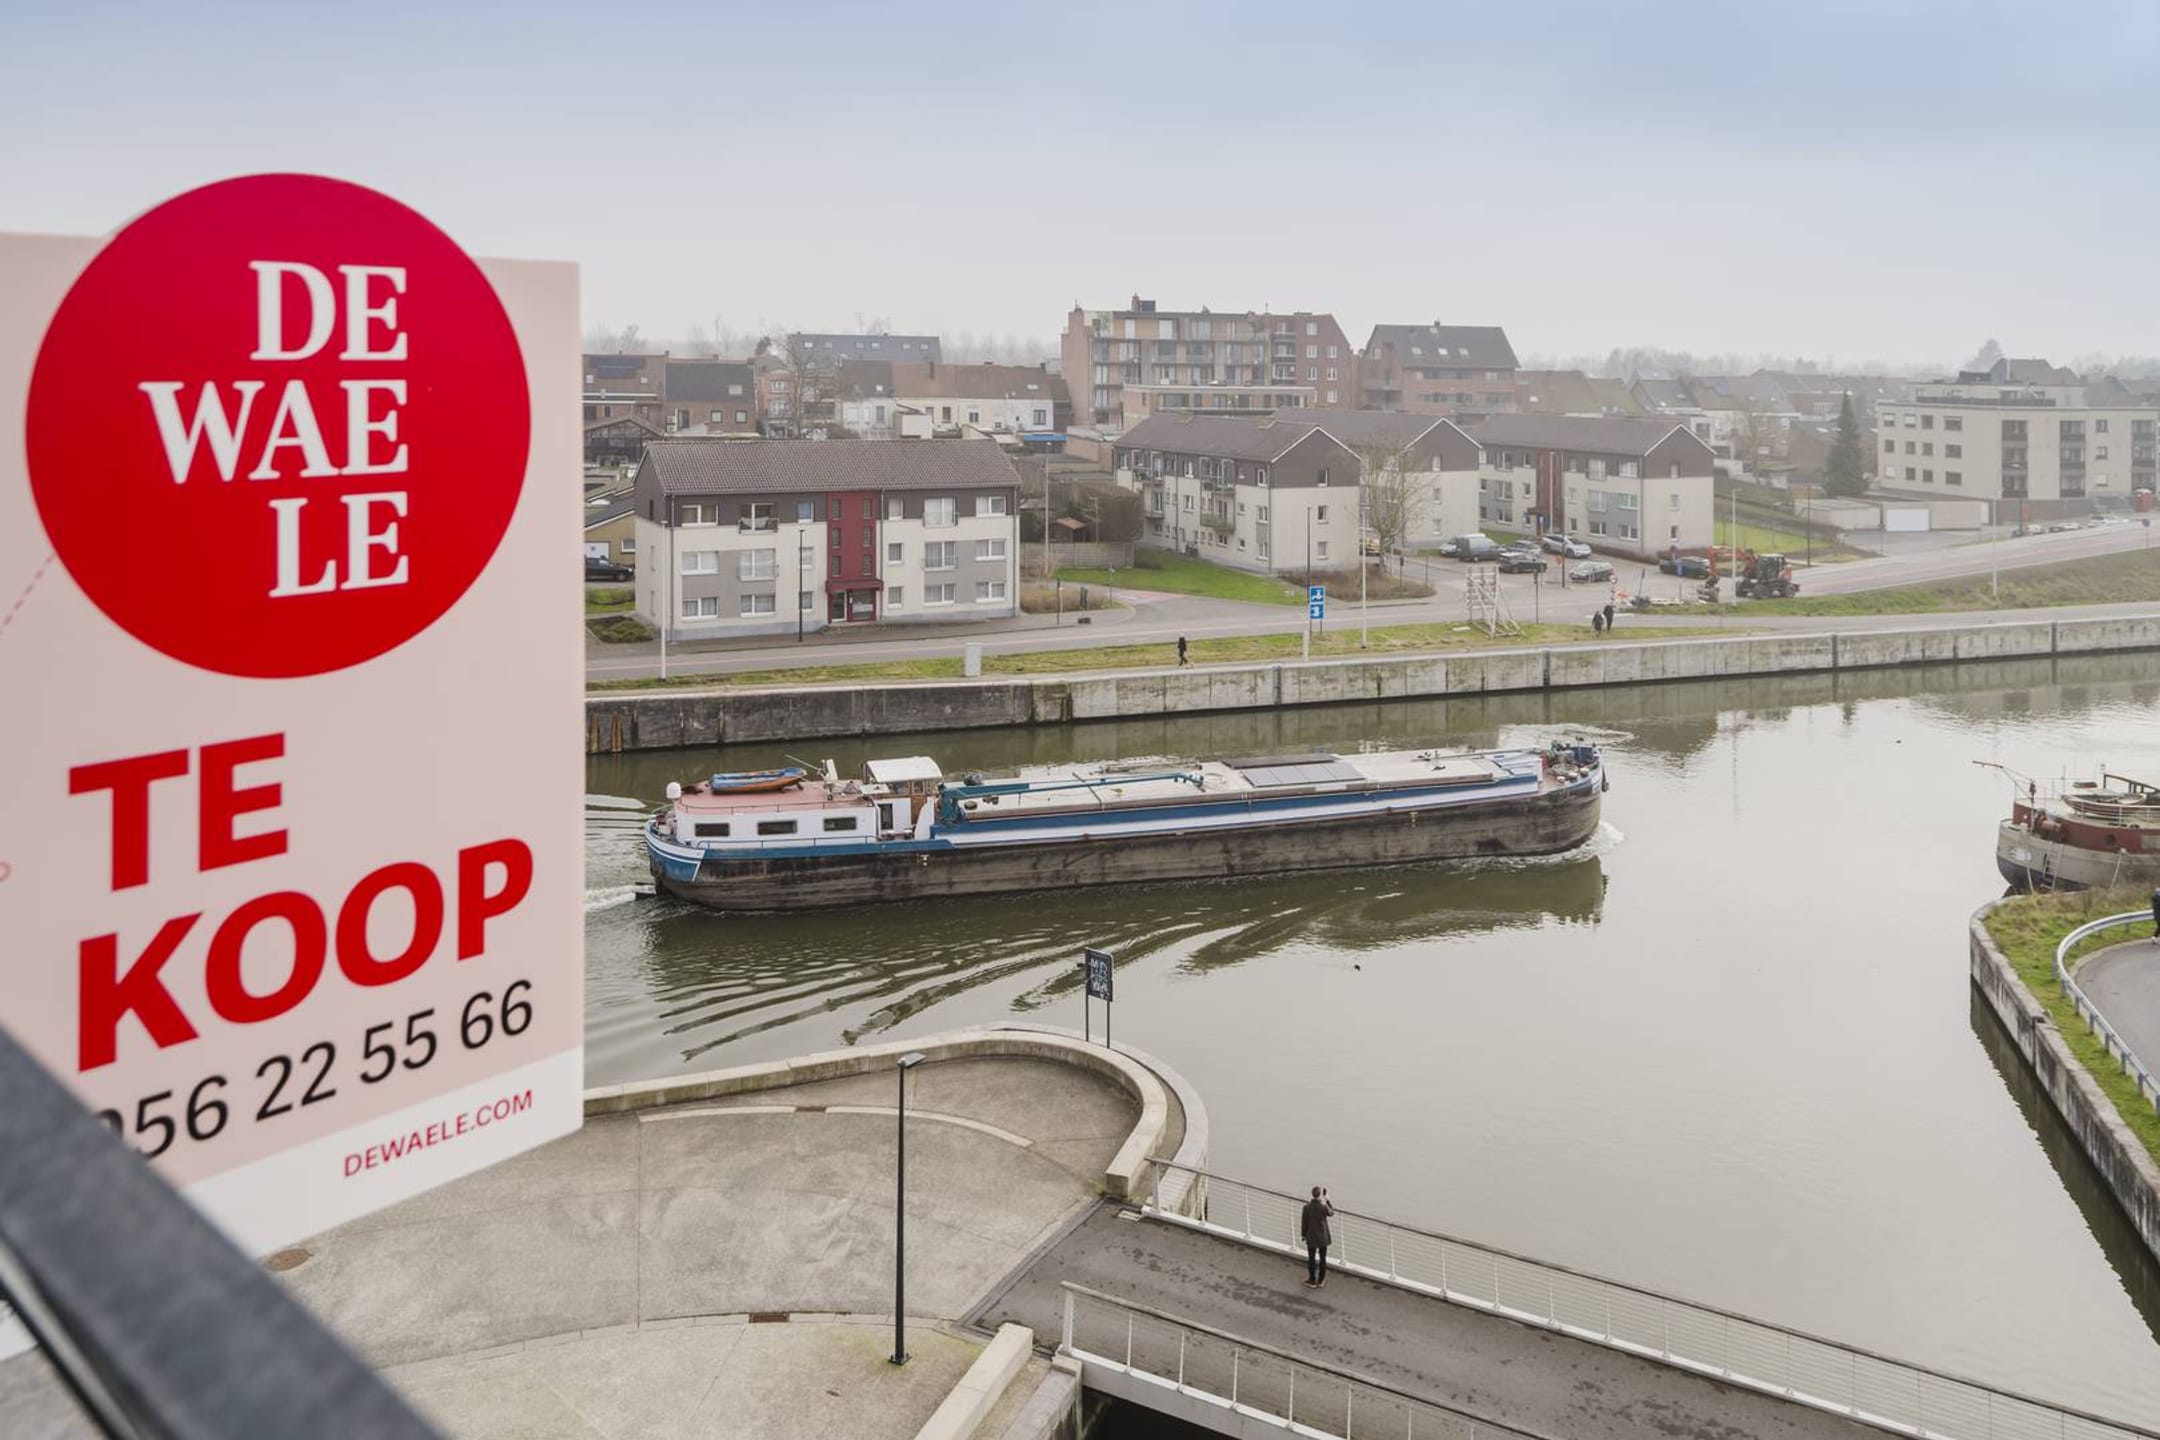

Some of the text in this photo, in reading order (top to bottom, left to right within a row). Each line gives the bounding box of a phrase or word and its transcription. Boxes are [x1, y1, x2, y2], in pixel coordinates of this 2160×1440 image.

[248, 260, 408, 361] DE
[138, 379, 409, 484] WAE
[268, 491, 409, 598] LE
[68, 731, 289, 892] TE
[78, 838, 534, 1074] KOOP
[254, 1041, 338, 1122] 22
[360, 1007, 438, 1085] 55
[460, 979, 533, 1050] 66
[343, 1089, 533, 1178] DEWAELE.COM
